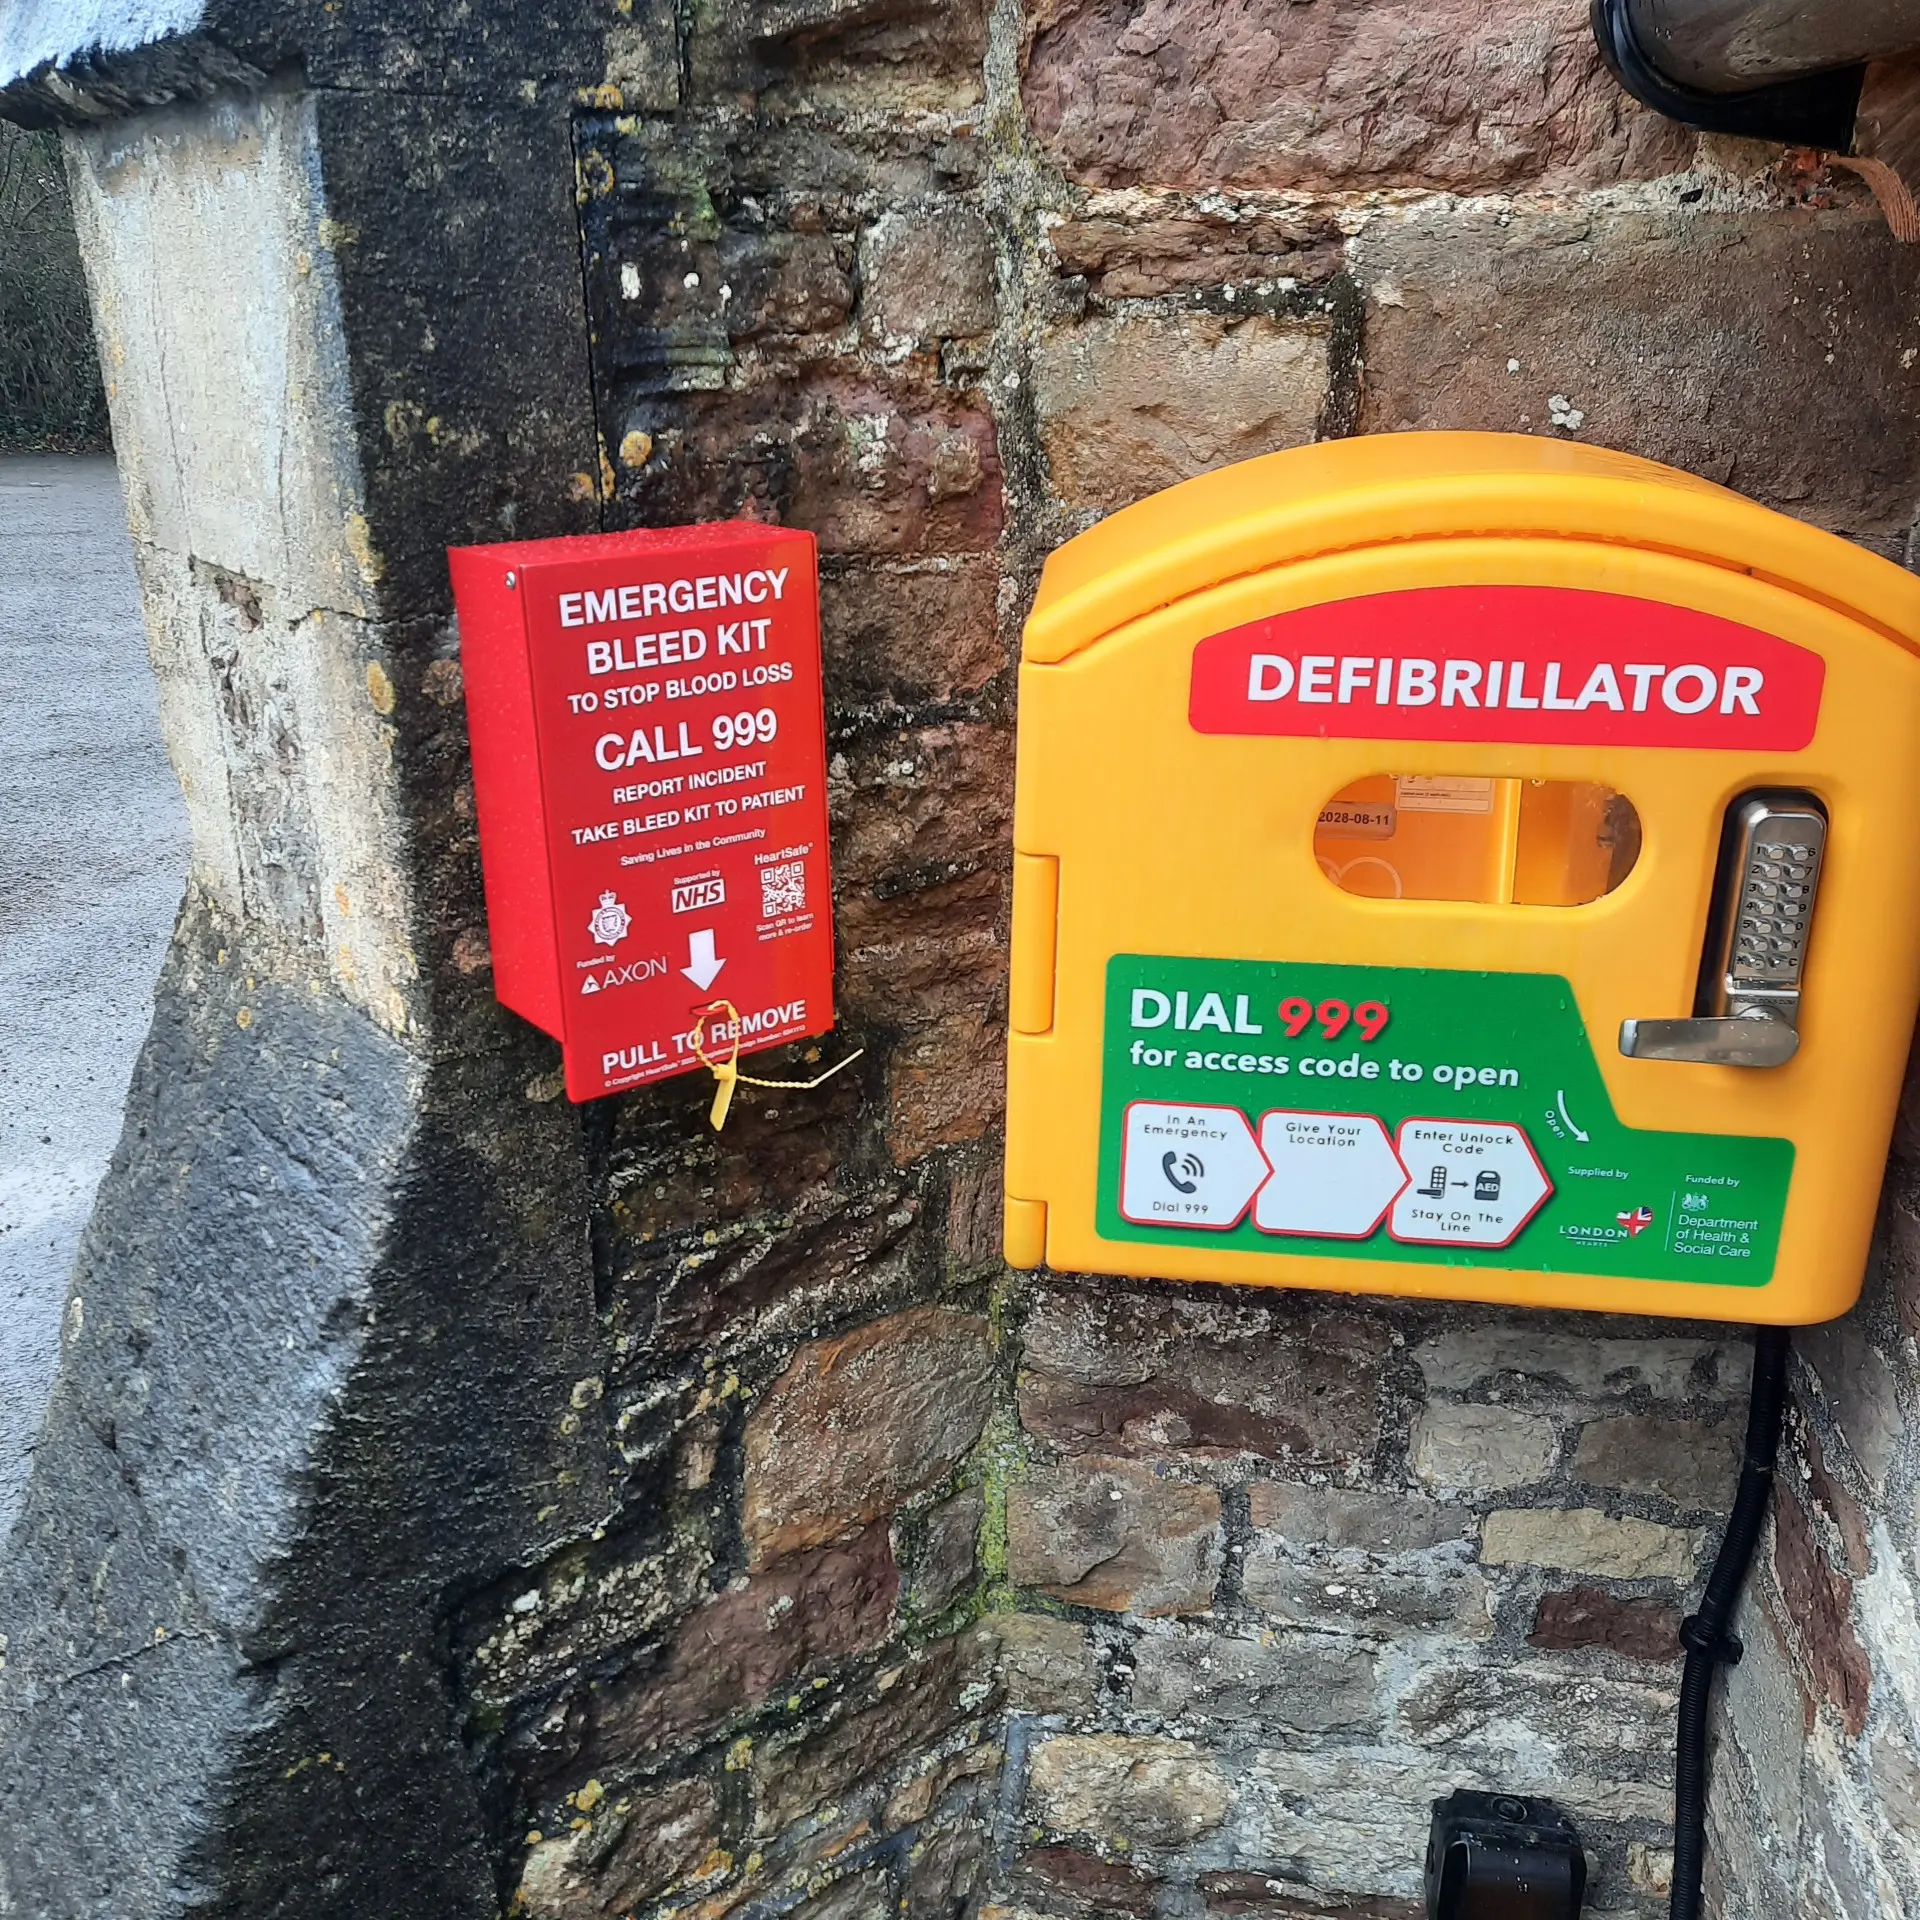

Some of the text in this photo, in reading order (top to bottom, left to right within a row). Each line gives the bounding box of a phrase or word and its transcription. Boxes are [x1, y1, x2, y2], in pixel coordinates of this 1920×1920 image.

[558, 567, 789, 627] EMERGENCY
[587, 618, 772, 675] BLEED KIT
[568, 662, 793, 714] TO STOP BLOOD LOSS
[1247, 653, 1764, 716] DEFIBRILLATOR
[594, 707, 778, 771] CALL 999
[613, 761, 767, 805] REPORT INCIDENT
[572, 784, 806, 845] TAKE BLEED KIT TO PATIENT
[1318, 811, 1389, 825] 2028-08-11
[621, 828, 766, 867] Saving Lives in the Community
[1756, 846, 1816, 857] 1 6
[674, 869, 721, 885] Supported by
[1751, 865, 1813, 876] 2 7
[675, 882, 721, 910] NHS
[1748, 883, 1810, 894] 3 8
[1746, 902, 1807, 912] 4 9
[756, 913, 814, 932] Scan QR to learn
[1742, 919, 1751, 928] 5
[758, 931, 777, 941] more
[784, 922, 812, 934] re-order
[1740, 937, 1801, 949] X Y
[605, 954, 616, 963] by
[1789, 958, 1798, 966] C
[602, 956, 667, 989] AXON
[1130, 988, 1390, 1042] DIAL 999
[601, 1000, 807, 1075] PULL TO REMOVE
[1130, 1040, 1520, 1090] for access code to open
[1167, 1115, 1206, 1127] In An
[1285, 1121, 1361, 1137] Give Your
[1544, 1109, 1566, 1139] Open
[1143, 1124, 1229, 1142] Emergency
[1289, 1133, 1356, 1147] Location
[1414, 1128, 1514, 1146] Enter Unlock
[1442, 1142, 1485, 1156] Code
[1567, 1166, 1629, 1180] Supplied by
[1686, 1174, 1740, 1188] Funded by
[1476, 1182, 1500, 1193] AED
[1152, 1200, 1209, 1215] Dial 999
[1411, 1208, 1504, 1224] Stay On The
[1679, 1214, 1759, 1231] Department
[1440, 1221, 1471, 1233] Line
[1559, 1225, 1628, 1238] LONDON
[1676, 1228, 1750, 1244] of Health &
[1674, 1242, 1751, 1258] Social Care
